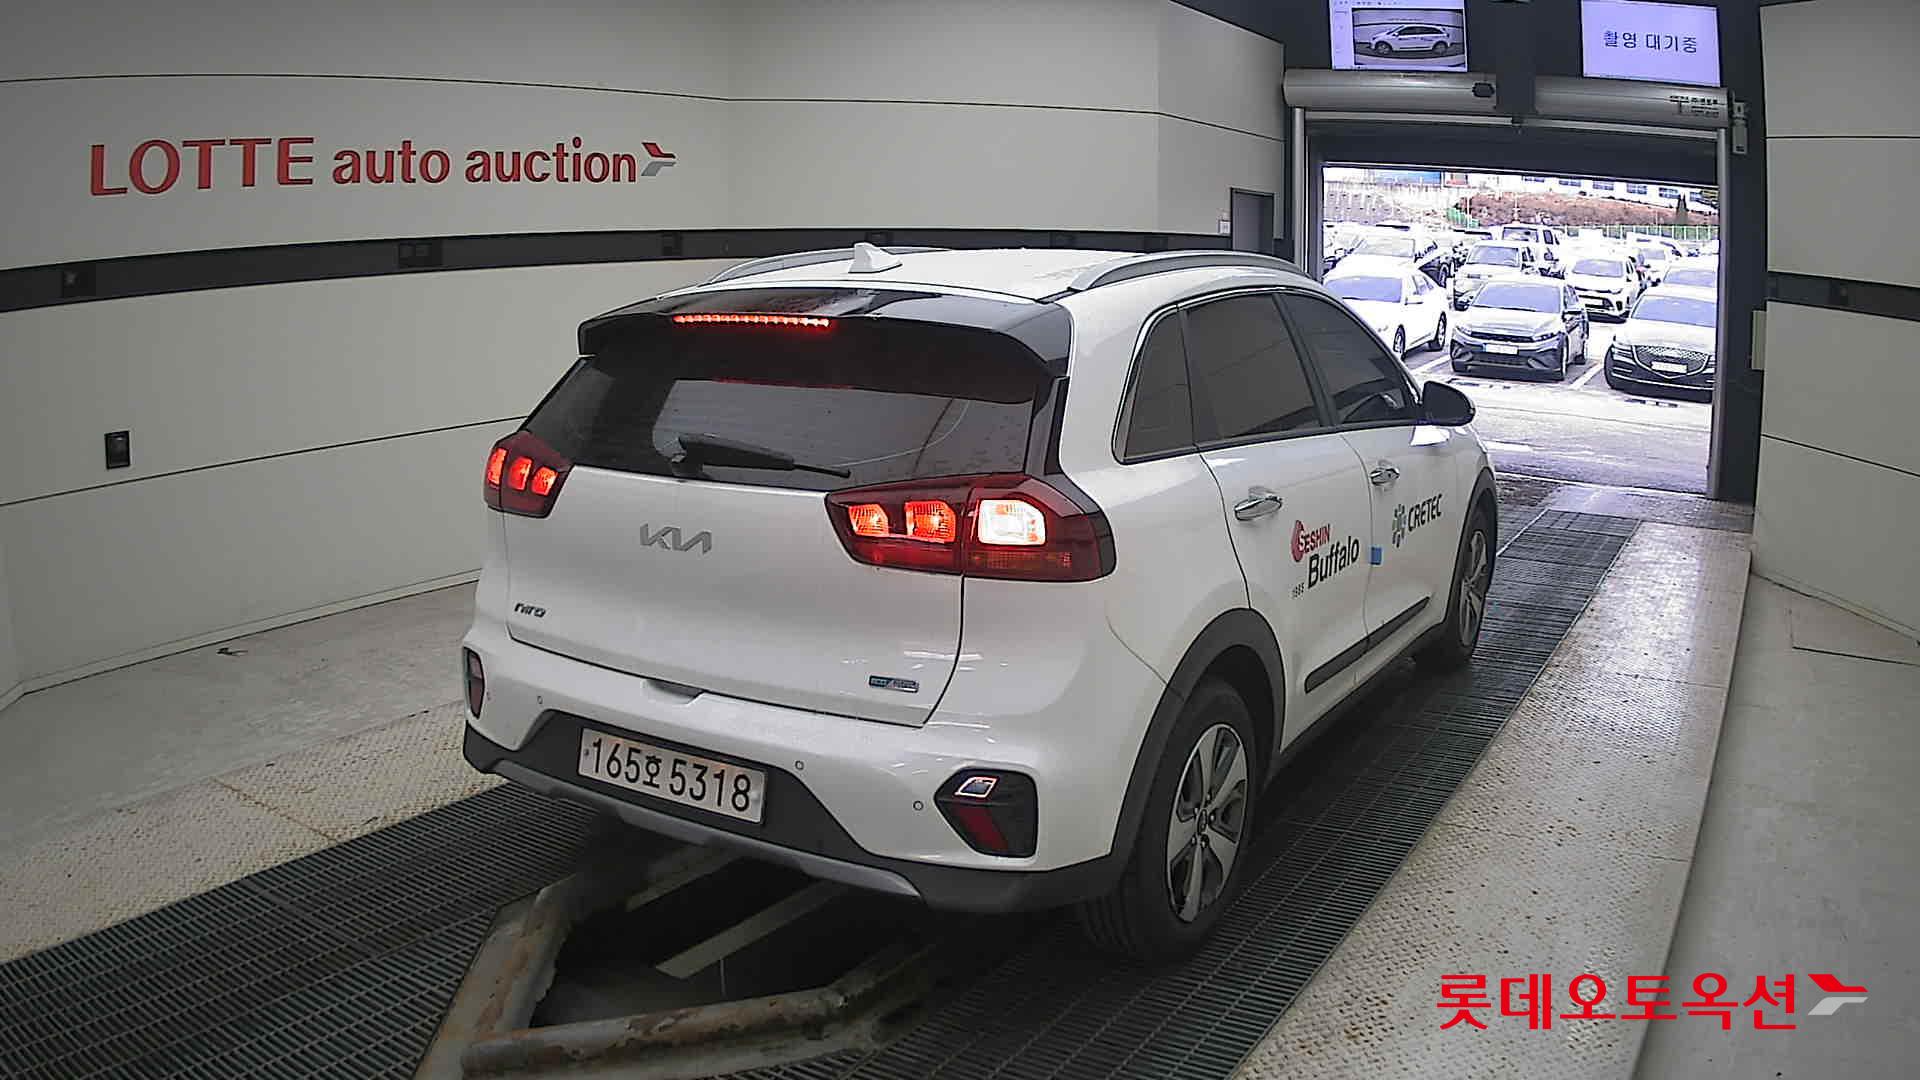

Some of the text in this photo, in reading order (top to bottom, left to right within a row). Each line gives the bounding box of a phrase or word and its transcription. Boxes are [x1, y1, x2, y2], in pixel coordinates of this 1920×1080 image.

[1603, 31, 1637, 49] 촬영
[90, 135, 638, 197] LOTTE auto auction
[1408, 493, 1443, 532] CRETEC
[639, 523, 713, 554] KIA
[1307, 535, 1360, 589] Buffalo
